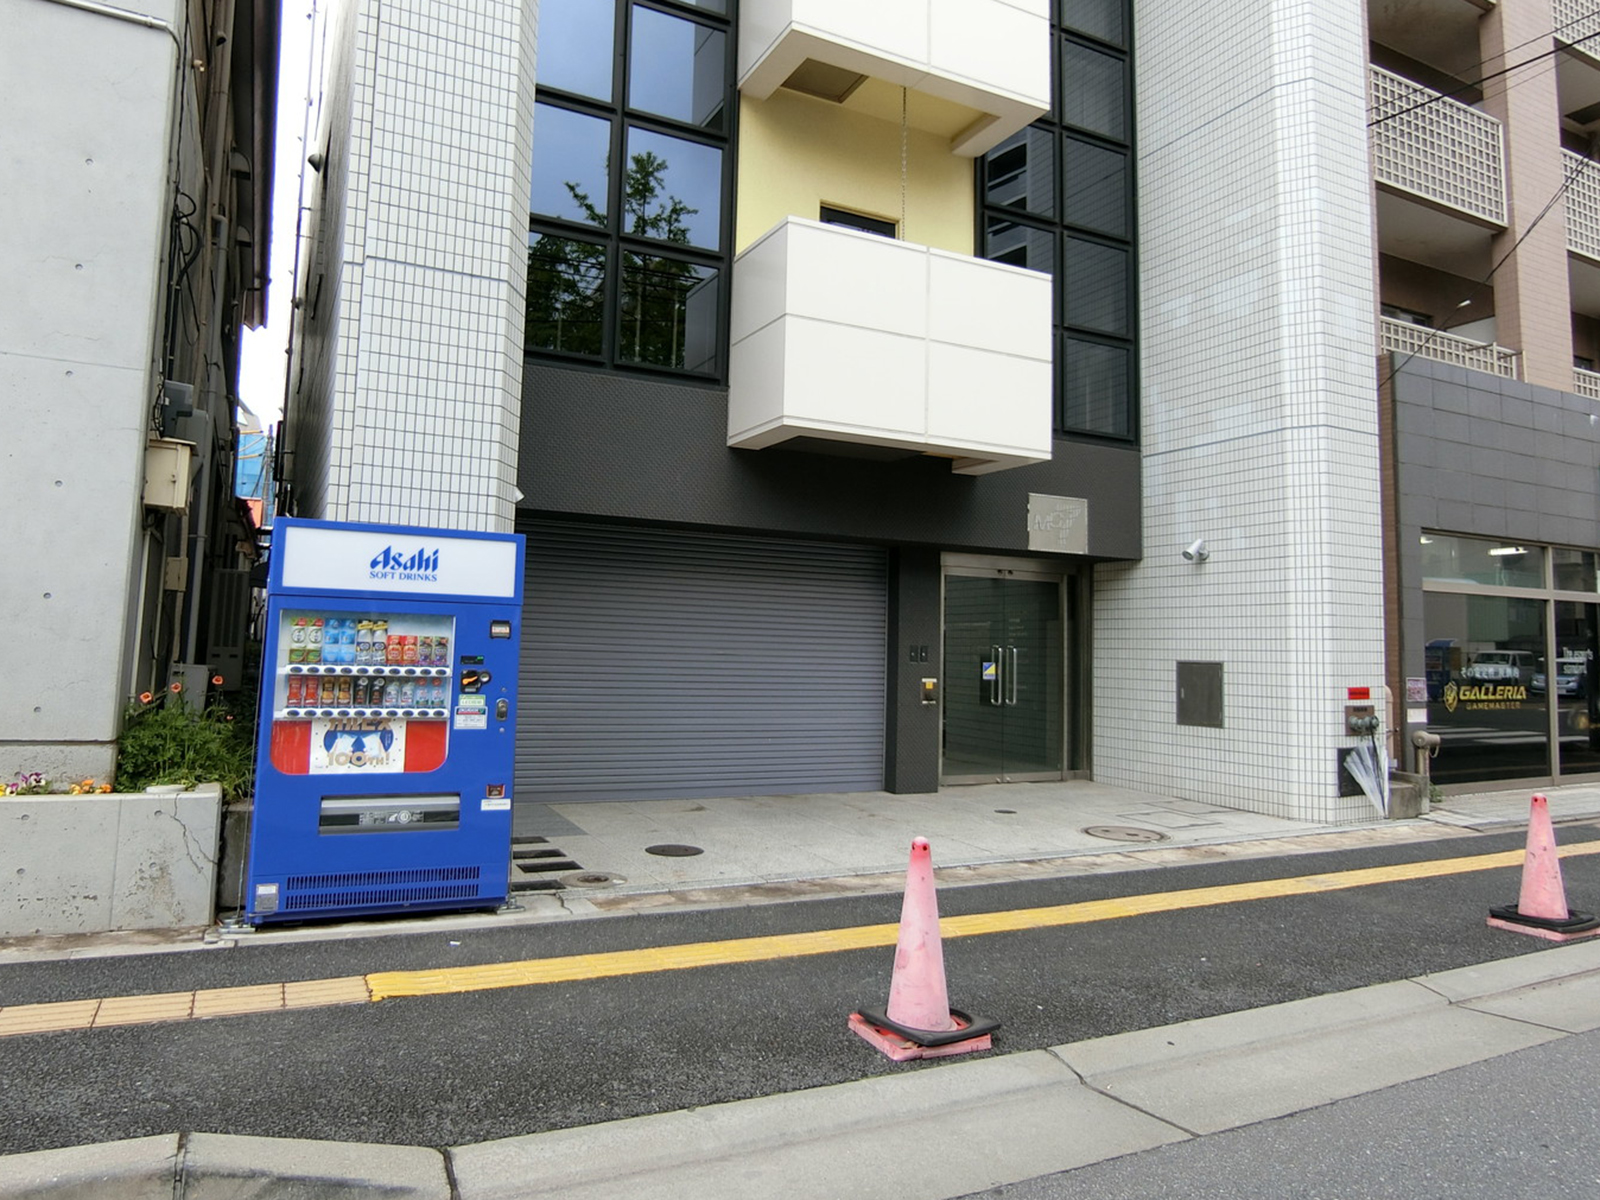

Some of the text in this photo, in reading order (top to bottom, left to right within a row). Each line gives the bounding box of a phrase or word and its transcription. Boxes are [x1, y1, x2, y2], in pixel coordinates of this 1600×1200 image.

[370, 545, 439, 573] Asahi
[369, 571, 437, 582] SOFT DRINKS
[1459, 686, 1527, 700] GALLERIA
